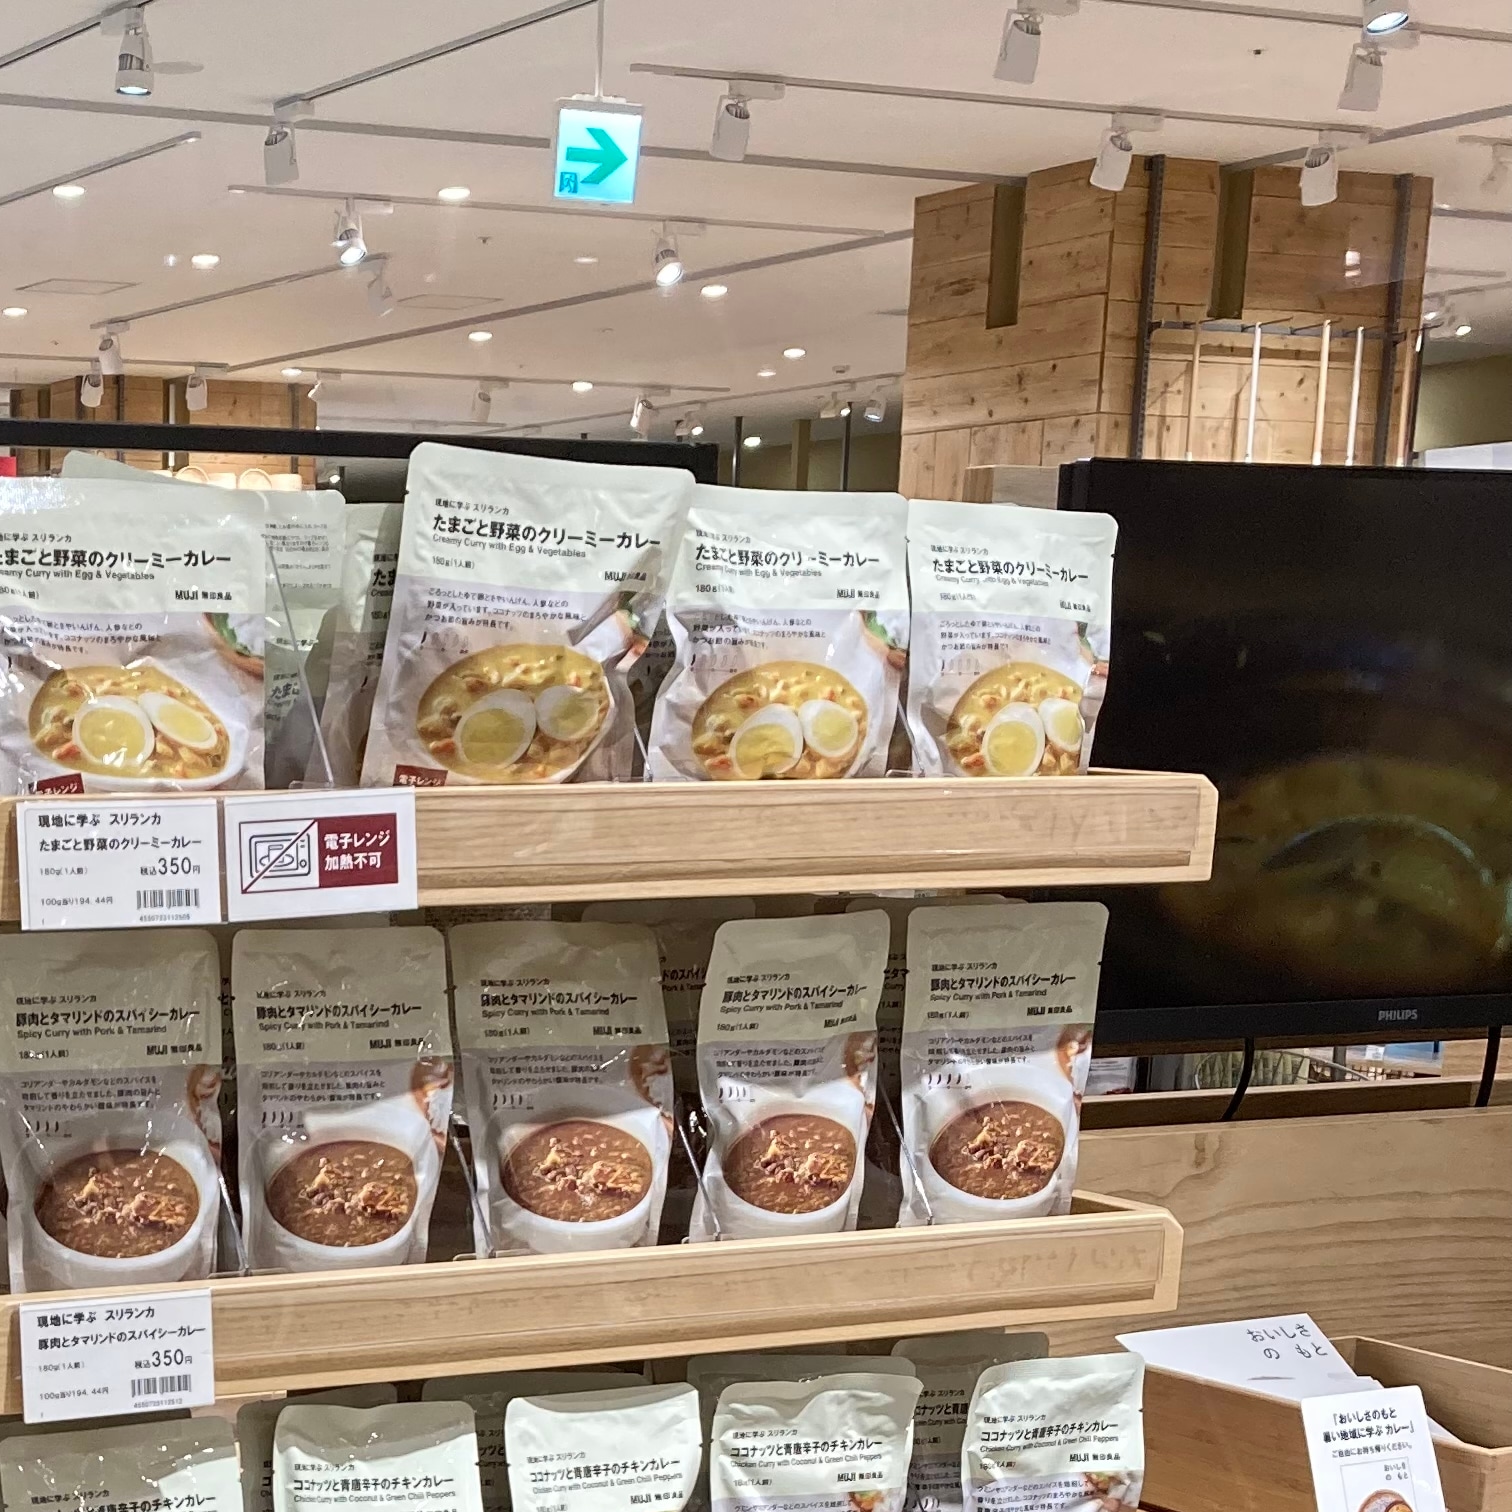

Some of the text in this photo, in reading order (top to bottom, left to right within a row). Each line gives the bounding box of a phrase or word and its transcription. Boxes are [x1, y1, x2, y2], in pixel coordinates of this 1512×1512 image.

[473, 503, 509, 516] スリランカ
[32, 534, 72, 543] スリランカ
[433, 513, 660, 549] たまごと野菜のクリーミーカレー
[175, 590, 232, 600] MUJI 無印良品
[38, 812, 162, 827] 現地に学ぶ スリランカ
[39, 839, 202, 853] たまごと野菜のクリーミーカレー
[324, 830, 389, 849] 電子レンジ
[324, 852, 382, 870] 加熱不可
[931, 973, 1076, 991] 豚肉とタマリンドのスパイシーカレー
[16, 1008, 200, 1027] 豚肉とタマリンドのスパイシーカレー
[1378, 1009, 1417, 1021] PHILIPS
[37, 1306, 155, 1328] 現地に学ぶ スリランカ
[38, 1326, 206, 1350] 豚肉とタマリンドのスパイシーカレー
[1247, 1324, 1311, 1342] おいしさ
[1264, 1343, 1327, 1359] の もと
[1333, 1408, 1397, 1426] 「おいしさのもと
[294, 1476, 453, 1492] ココナッツと青唐辛子のチキンカレー
